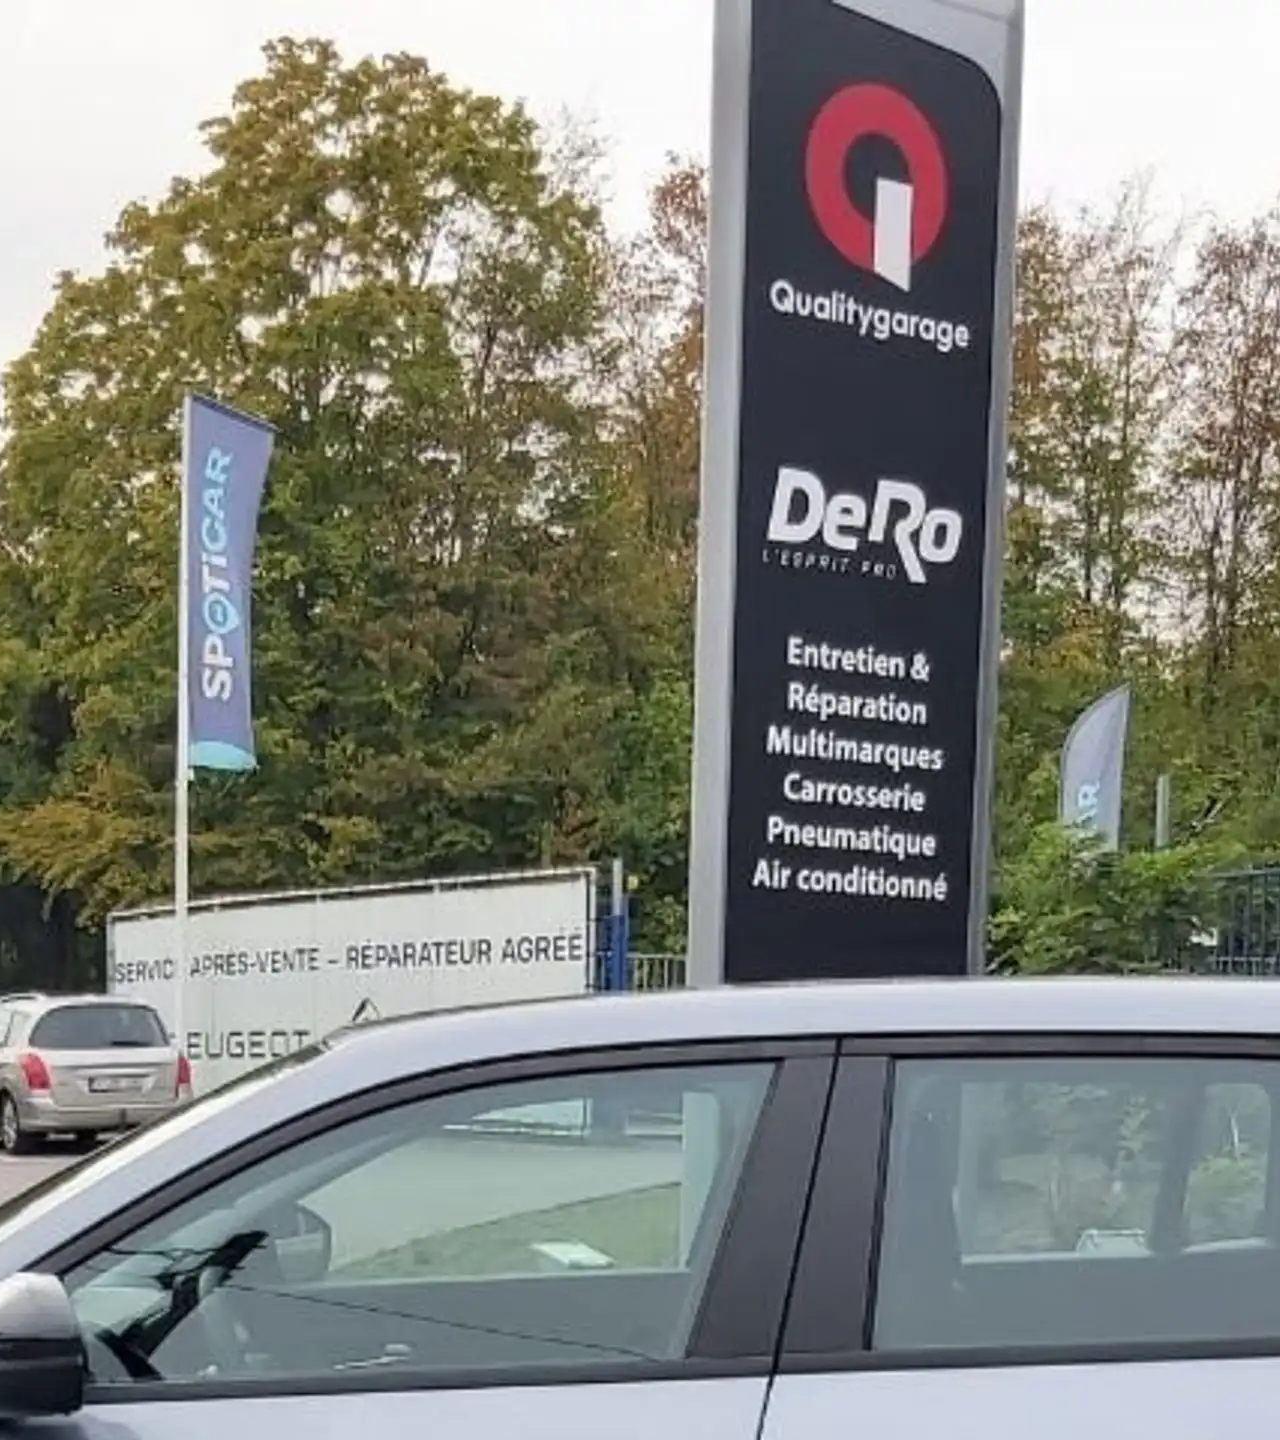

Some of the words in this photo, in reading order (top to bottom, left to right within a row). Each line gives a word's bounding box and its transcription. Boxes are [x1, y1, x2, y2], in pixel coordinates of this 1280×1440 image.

[769, 278, 970, 353] Qualitygarage
[766, 465, 964, 584] DeRo
[786, 635, 906, 679] Entretien
[909, 652, 931, 682] &
[786, 681, 928, 725] Réparation
[765, 724, 944, 773] Multimarques
[782, 771, 927, 812] Carrosserie
[767, 814, 937, 862] Pneumatique
[752, 858, 792, 890] Air
[796, 863, 949, 901] conditionné
[114, 958, 175, 983] SERVIC
[172, 1029, 312, 1060] EUGEOT
